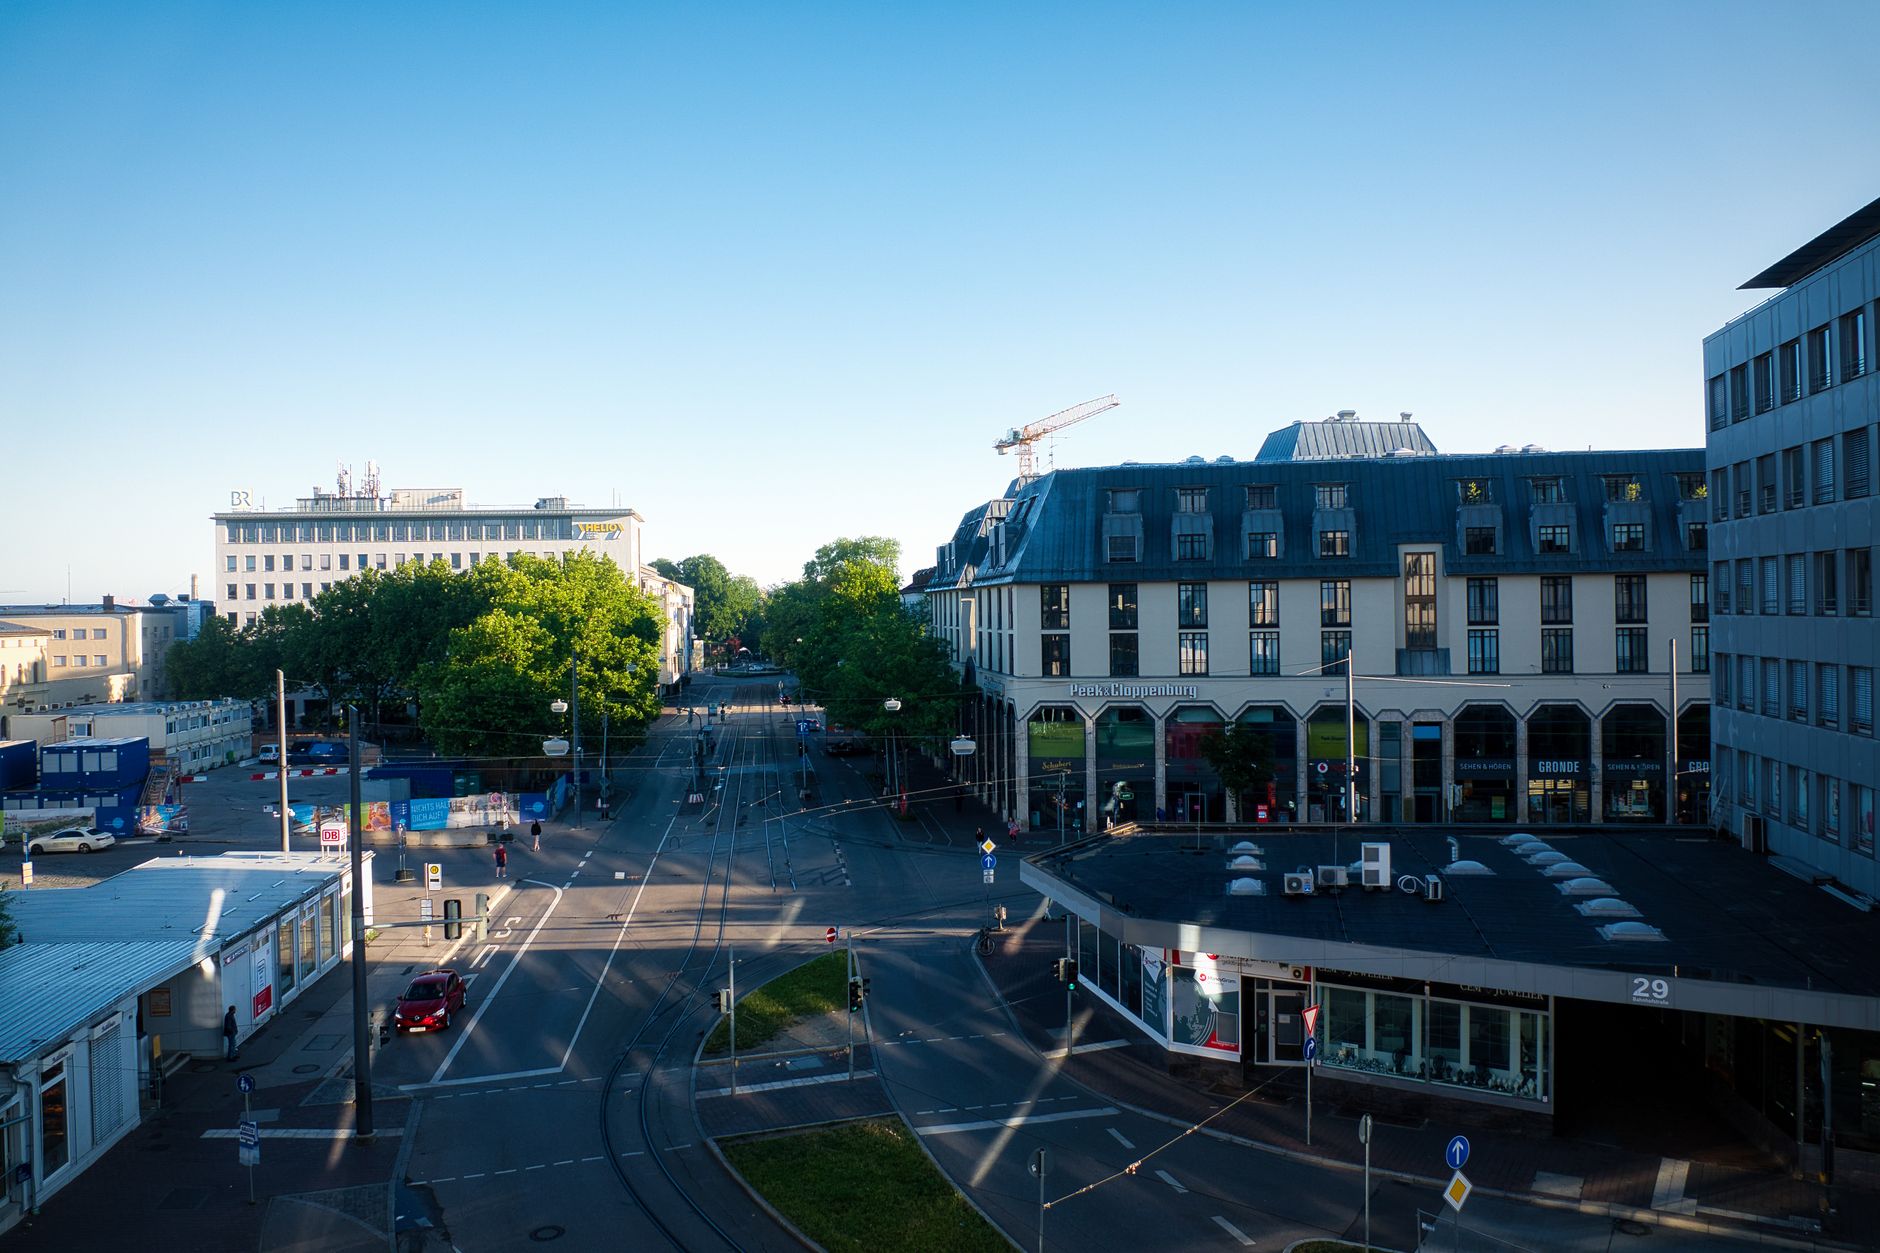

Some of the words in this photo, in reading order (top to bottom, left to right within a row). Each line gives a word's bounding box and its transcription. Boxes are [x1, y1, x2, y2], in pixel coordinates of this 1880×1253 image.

[231, 491, 251, 506] BR
[586, 523, 617, 532] HELIO
[1042, 760, 1072, 770] Schubert
[1460, 762, 1481, 770] SEHEN
[1482, 762, 1488, 770] &
[1489, 761, 1512, 770] HÖREN
[1539, 761, 1580, 773] GRONDE
[412, 803, 434, 812] NICHTS
[412, 813, 427, 822] DICH
[428, 811, 444, 820] AUF!
[325, 831, 338, 840] DB
[1633, 977, 1669, 999] 29
[1493, 987, 1545, 1001] JUWELIER
